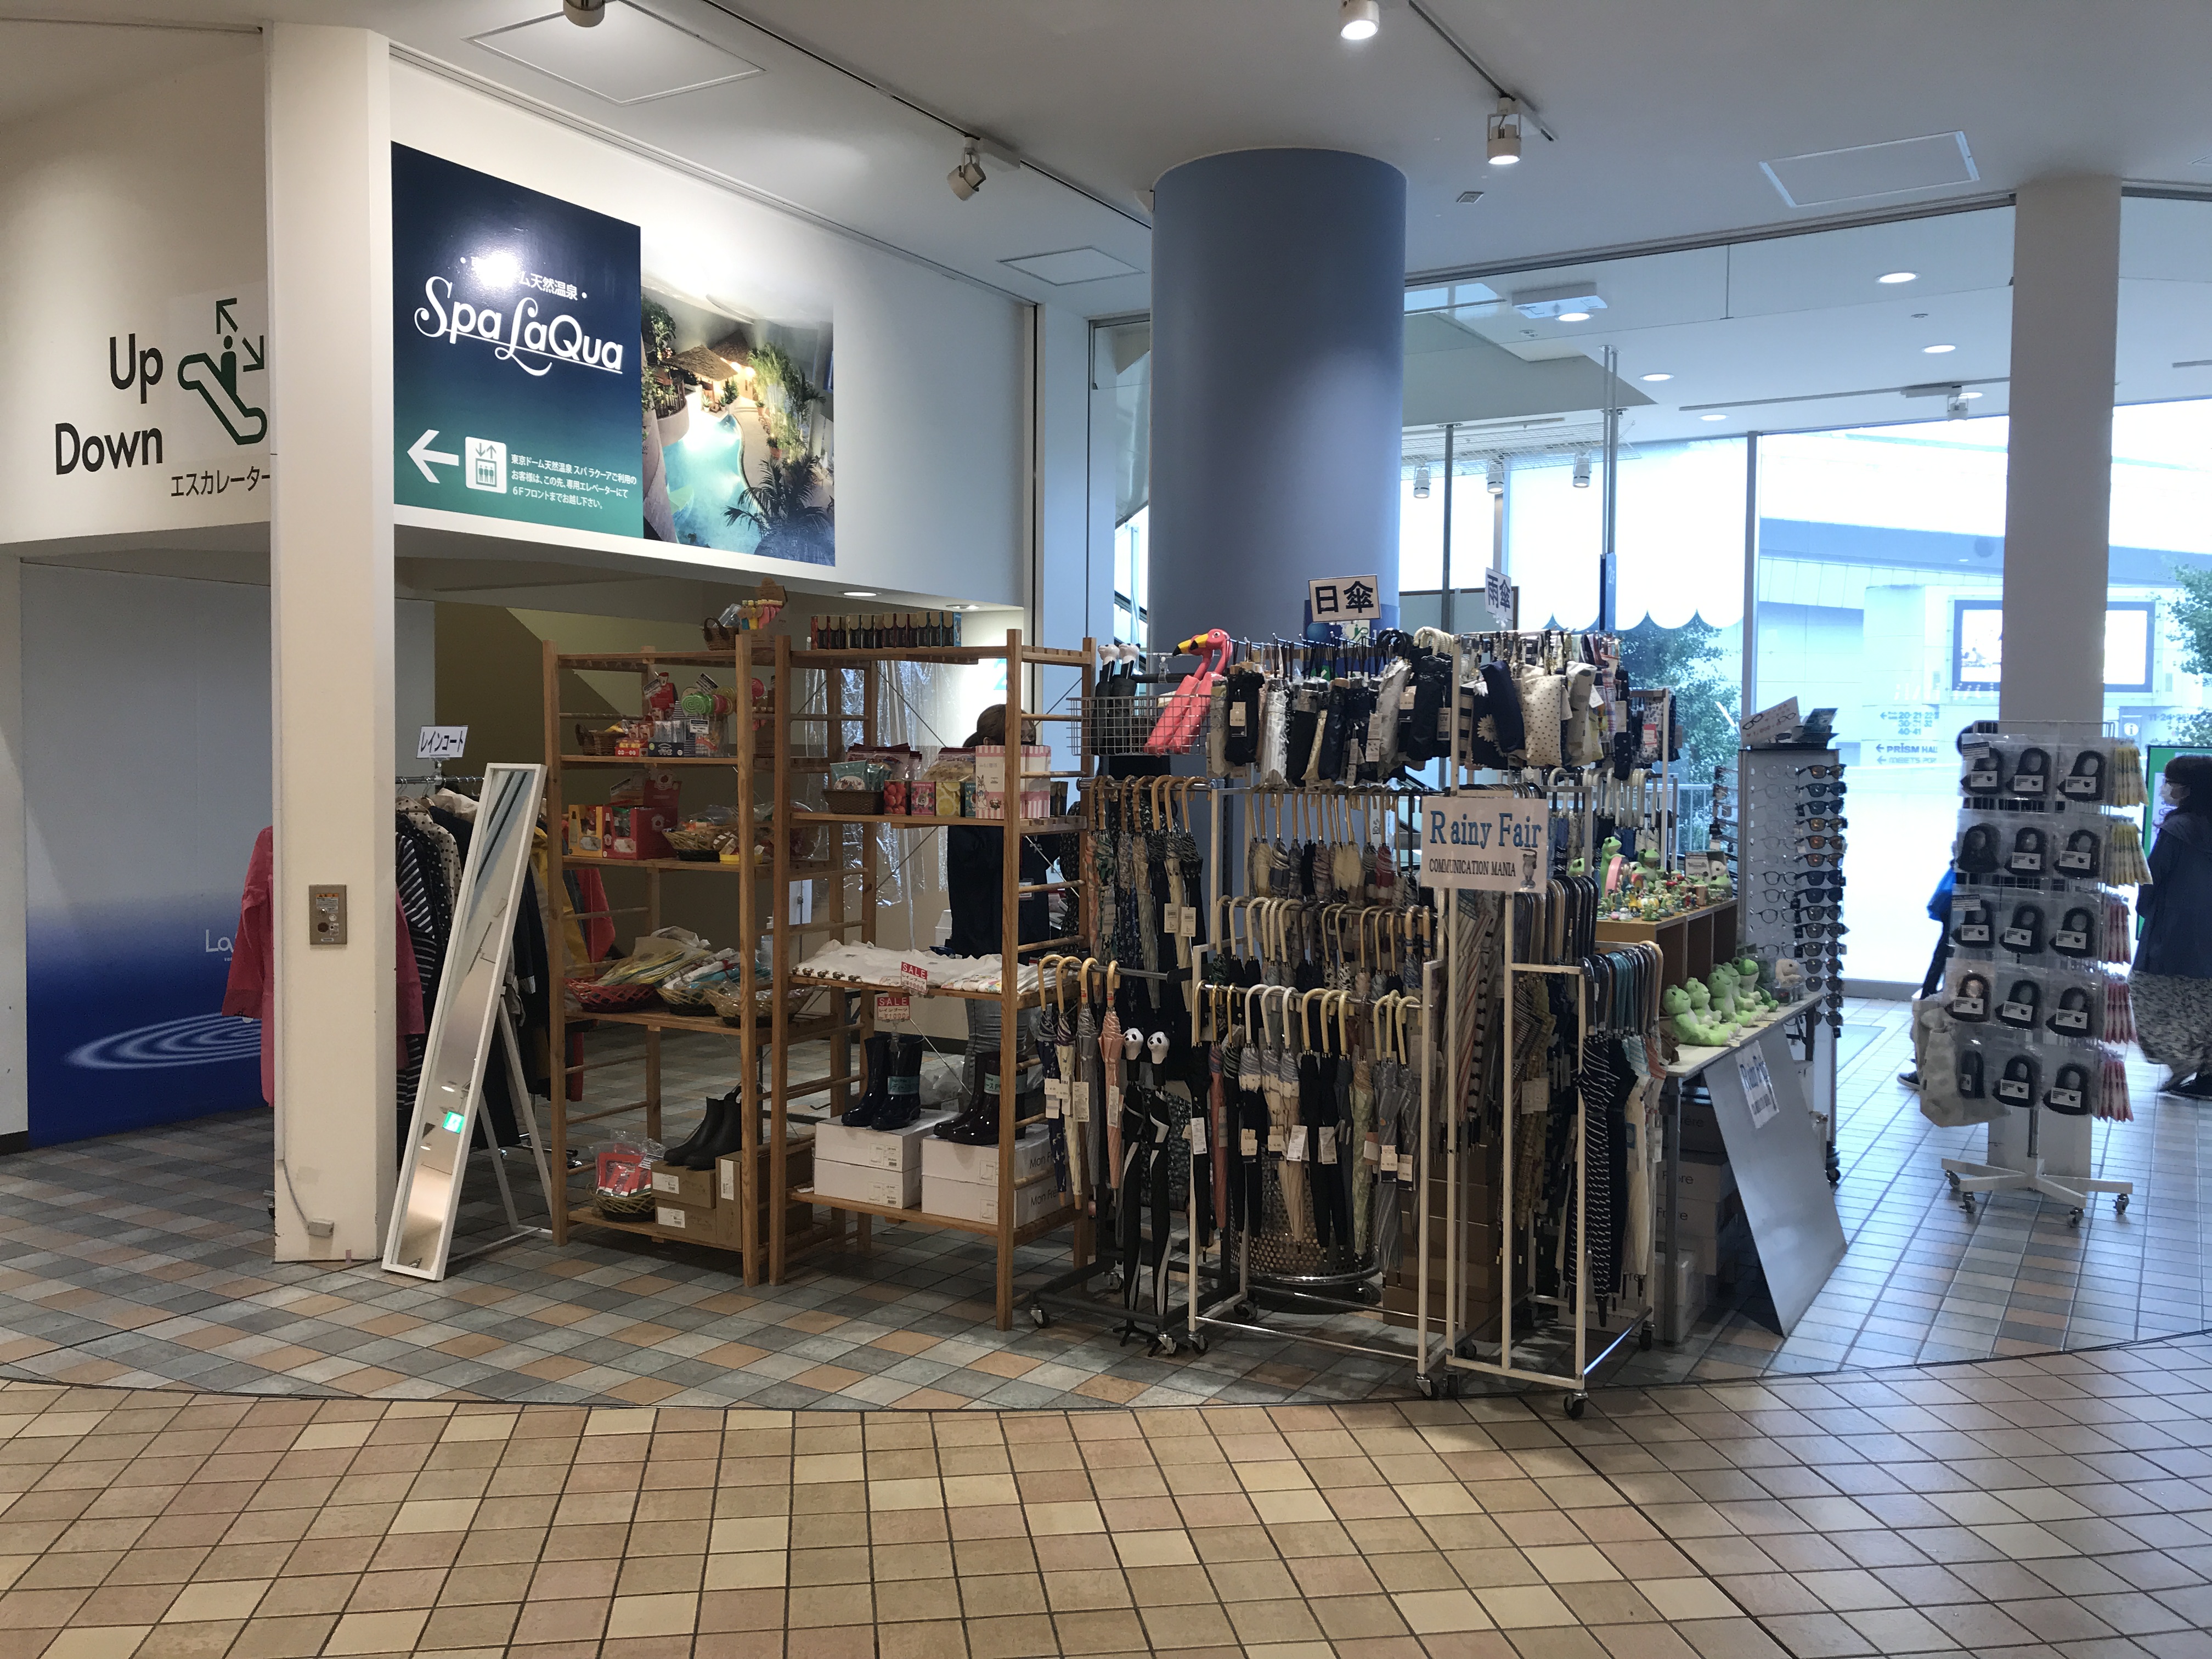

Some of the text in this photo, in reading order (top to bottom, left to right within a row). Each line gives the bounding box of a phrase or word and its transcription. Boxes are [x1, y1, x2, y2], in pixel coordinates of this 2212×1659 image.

[414, 276, 623, 376] Spa LaQua
[109, 333, 163, 404] Up
[55, 422, 163, 475] Down
[170, 466, 271, 498] エスカレーター
[1315, 580, 1374, 614] 日傘
[1487, 574, 1511, 612] 雨傘
[420, 730, 464, 753] レインコート
[1430, 810, 1542, 849] Rainy Fair
[1429, 858, 1516, 877] COMMUNICATION MANIA
[902, 963, 926, 979] SALE
[879, 997, 908, 1006] SALE
[1029, 1156, 1046, 1169] Mon
[1030, 1193, 1046, 1207] Mon
